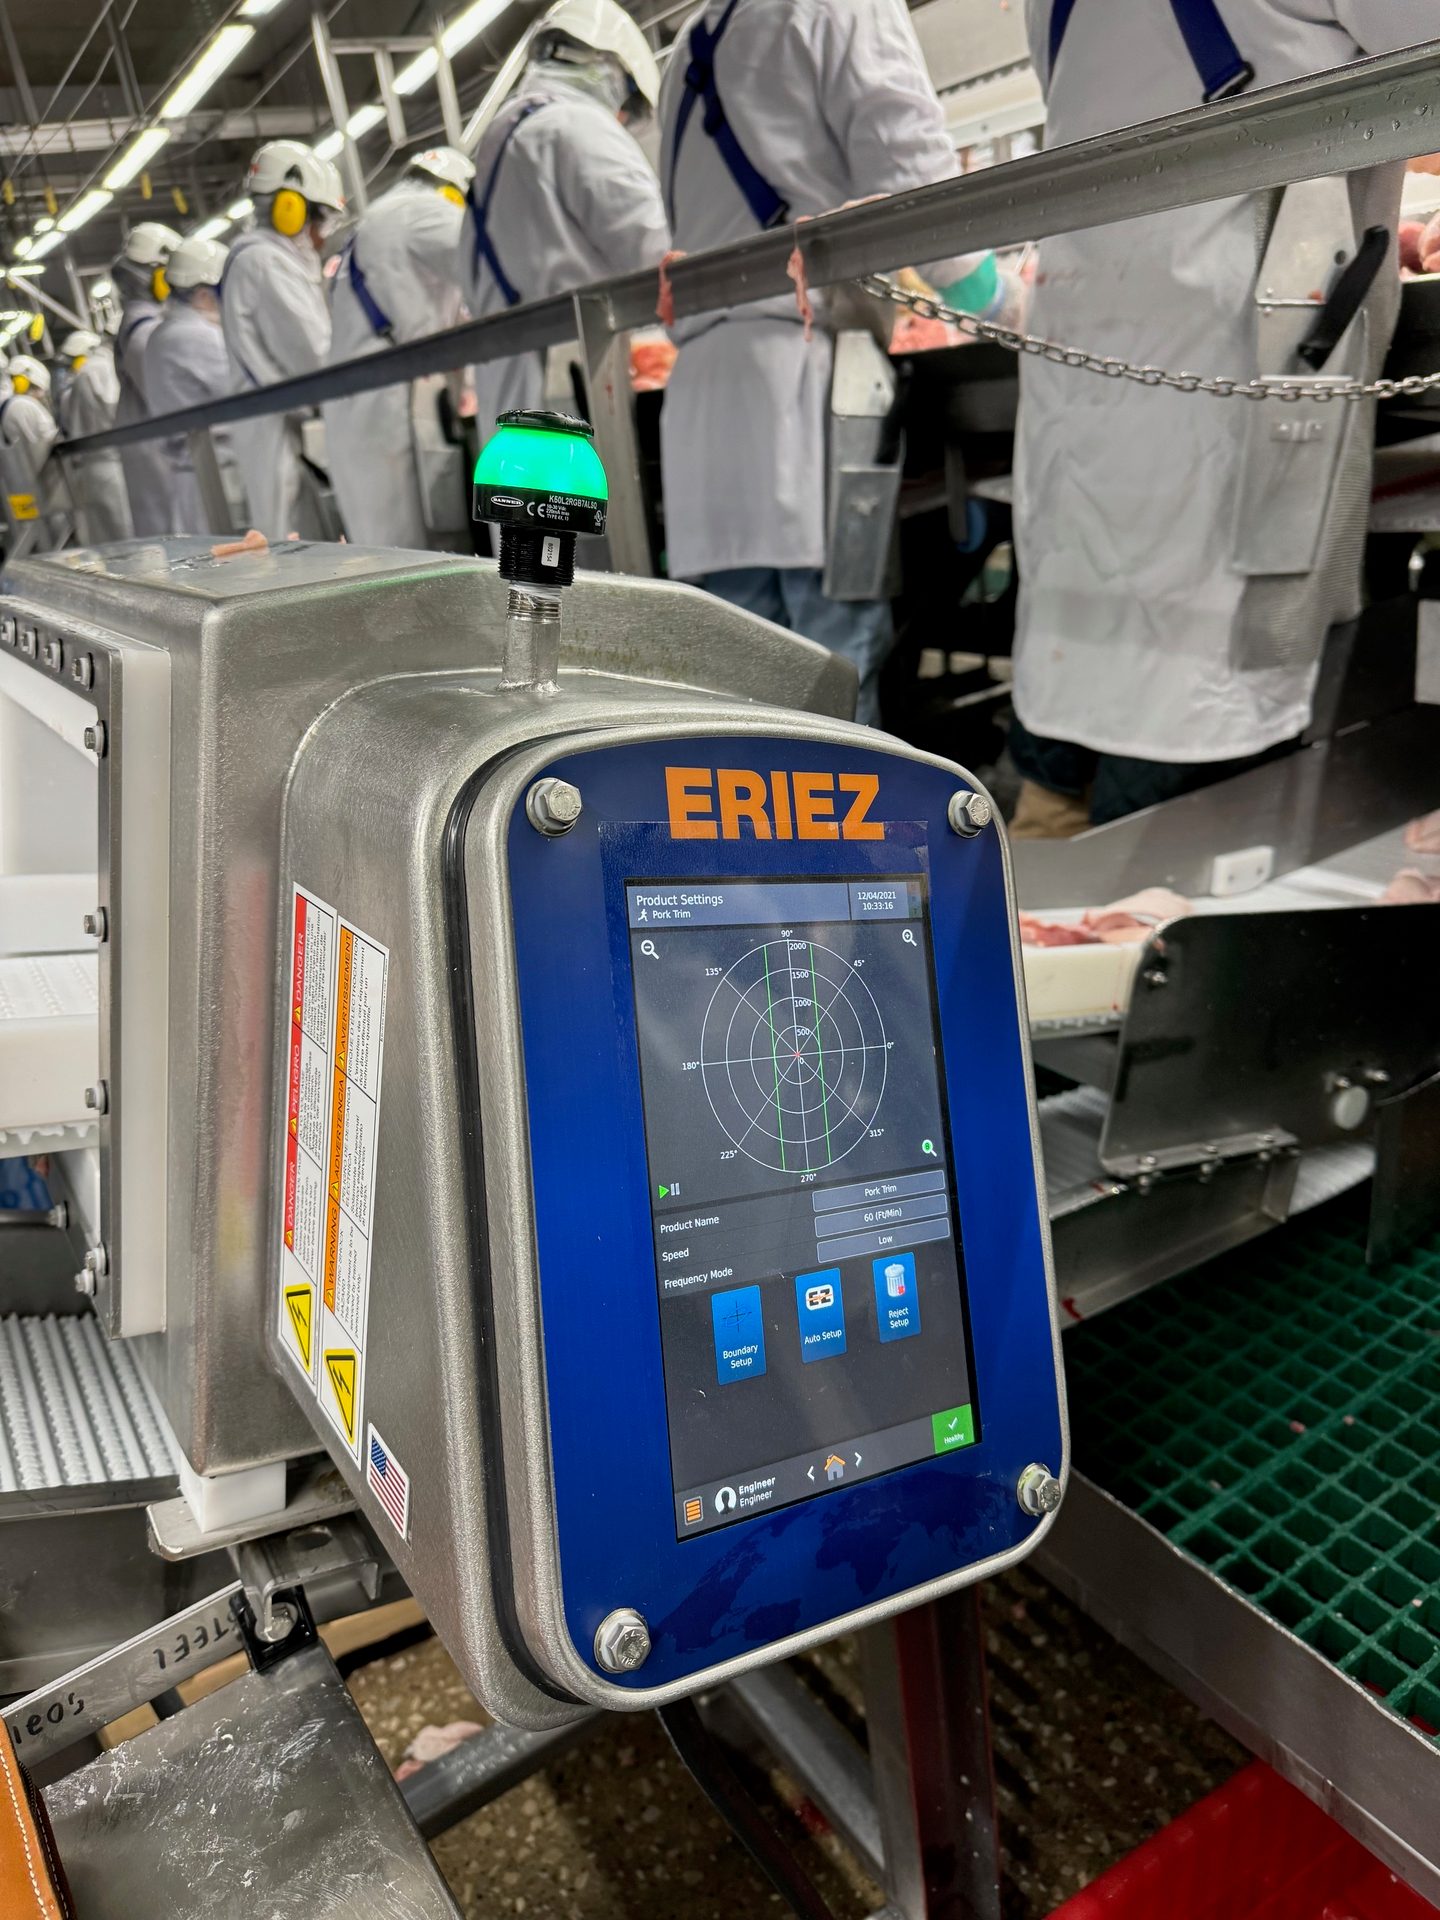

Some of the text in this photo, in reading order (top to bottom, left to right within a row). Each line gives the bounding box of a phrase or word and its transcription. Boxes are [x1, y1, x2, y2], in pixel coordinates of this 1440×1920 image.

[665, 766, 885, 840] ERIEZ
[636, 893, 724, 907] Product Settings
[857, 891, 897, 901] 12/04/2021
[863, 902, 894, 911] 10:33:16
[652, 909, 691, 919] Pork Trim
[781, 930, 793, 938] 90°
[789, 942, 807, 950] 2000
[853, 959, 865, 967] 45°
[705, 968, 723, 976] 135°
[792, 971, 809, 979] 1500
[342, 934, 350, 1049] AVERTISSEMENT
[794, 999, 812, 1007] 1000
[797, 1028, 810, 1036] 500
[682, 1061, 700, 1070] 180°
[335, 1080, 343, 1178] ADVERTENCIA
[869, 1128, 885, 1138] 315°
[720, 1150, 738, 1159] 225°
[800, 1173, 817, 1182] 270°
[864, 1185, 897, 1198] Pork Trim
[864, 1208, 902, 1222] 60 (Ft/Min)
[660, 1215, 720, 1234] Product Name
[878, 1235, 893, 1245] Low
[662, 1248, 690, 1262] Speed
[664, 1267, 733, 1289] Frequency Mode
[888, 1307, 909, 1320] Reject
[890, 1317, 909, 1329] Setup
[804, 1328, 843, 1344] Auto Setup
[723, 1344, 758, 1360] Boundary
[731, 1357, 753, 1369] Setup
[944, 1432, 965, 1445] Healthy
[739, 1476, 776, 1495] Engineer
[739, 1489, 773, 1508] Engineer
